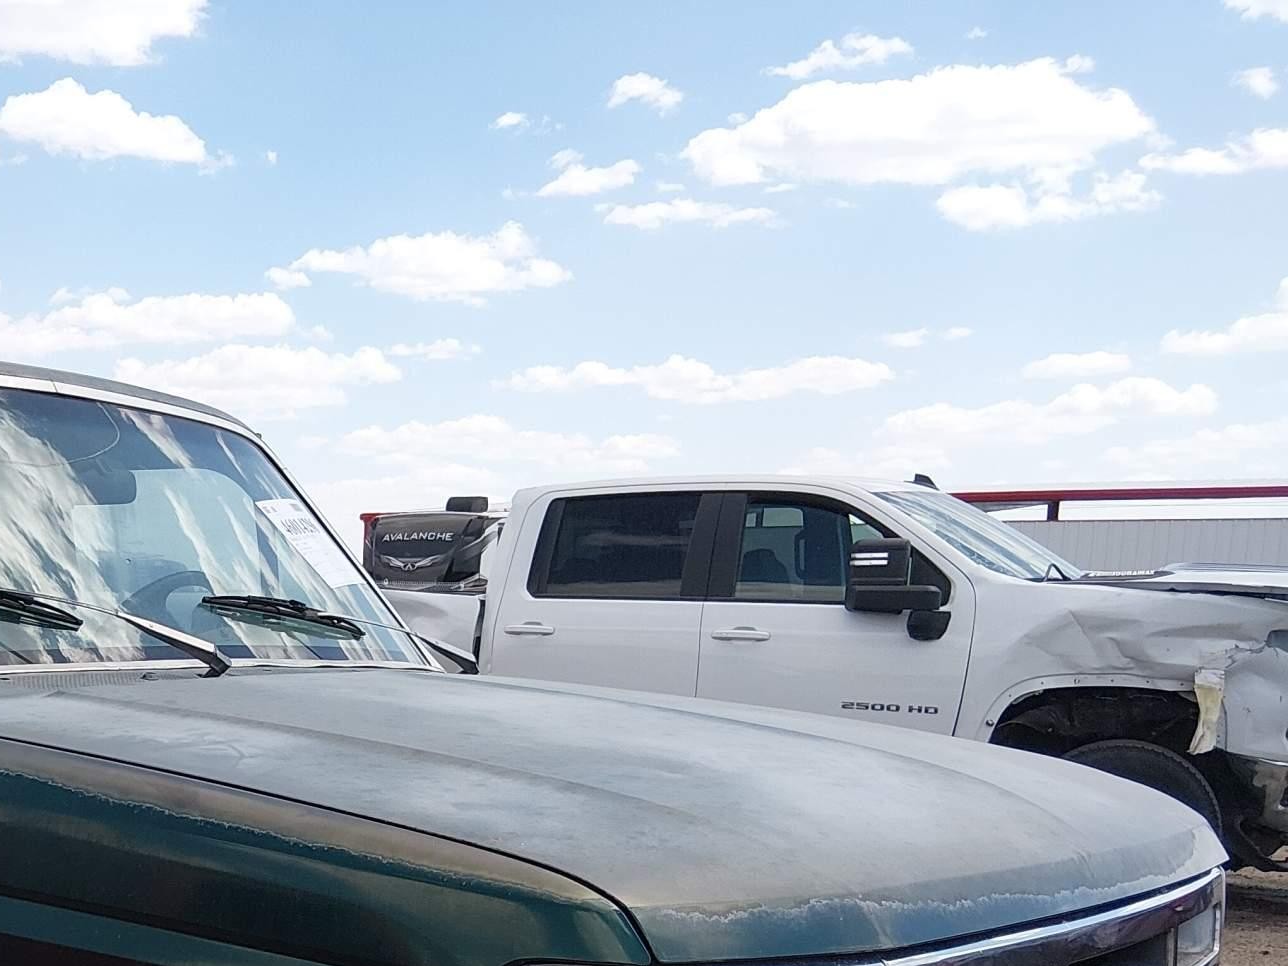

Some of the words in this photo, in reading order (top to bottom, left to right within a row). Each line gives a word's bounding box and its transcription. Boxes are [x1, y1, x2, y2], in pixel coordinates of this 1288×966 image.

[382, 532, 454, 542] AVALANCHE
[841, 701, 901, 713] 2500
[908, 704, 939, 715] HD
